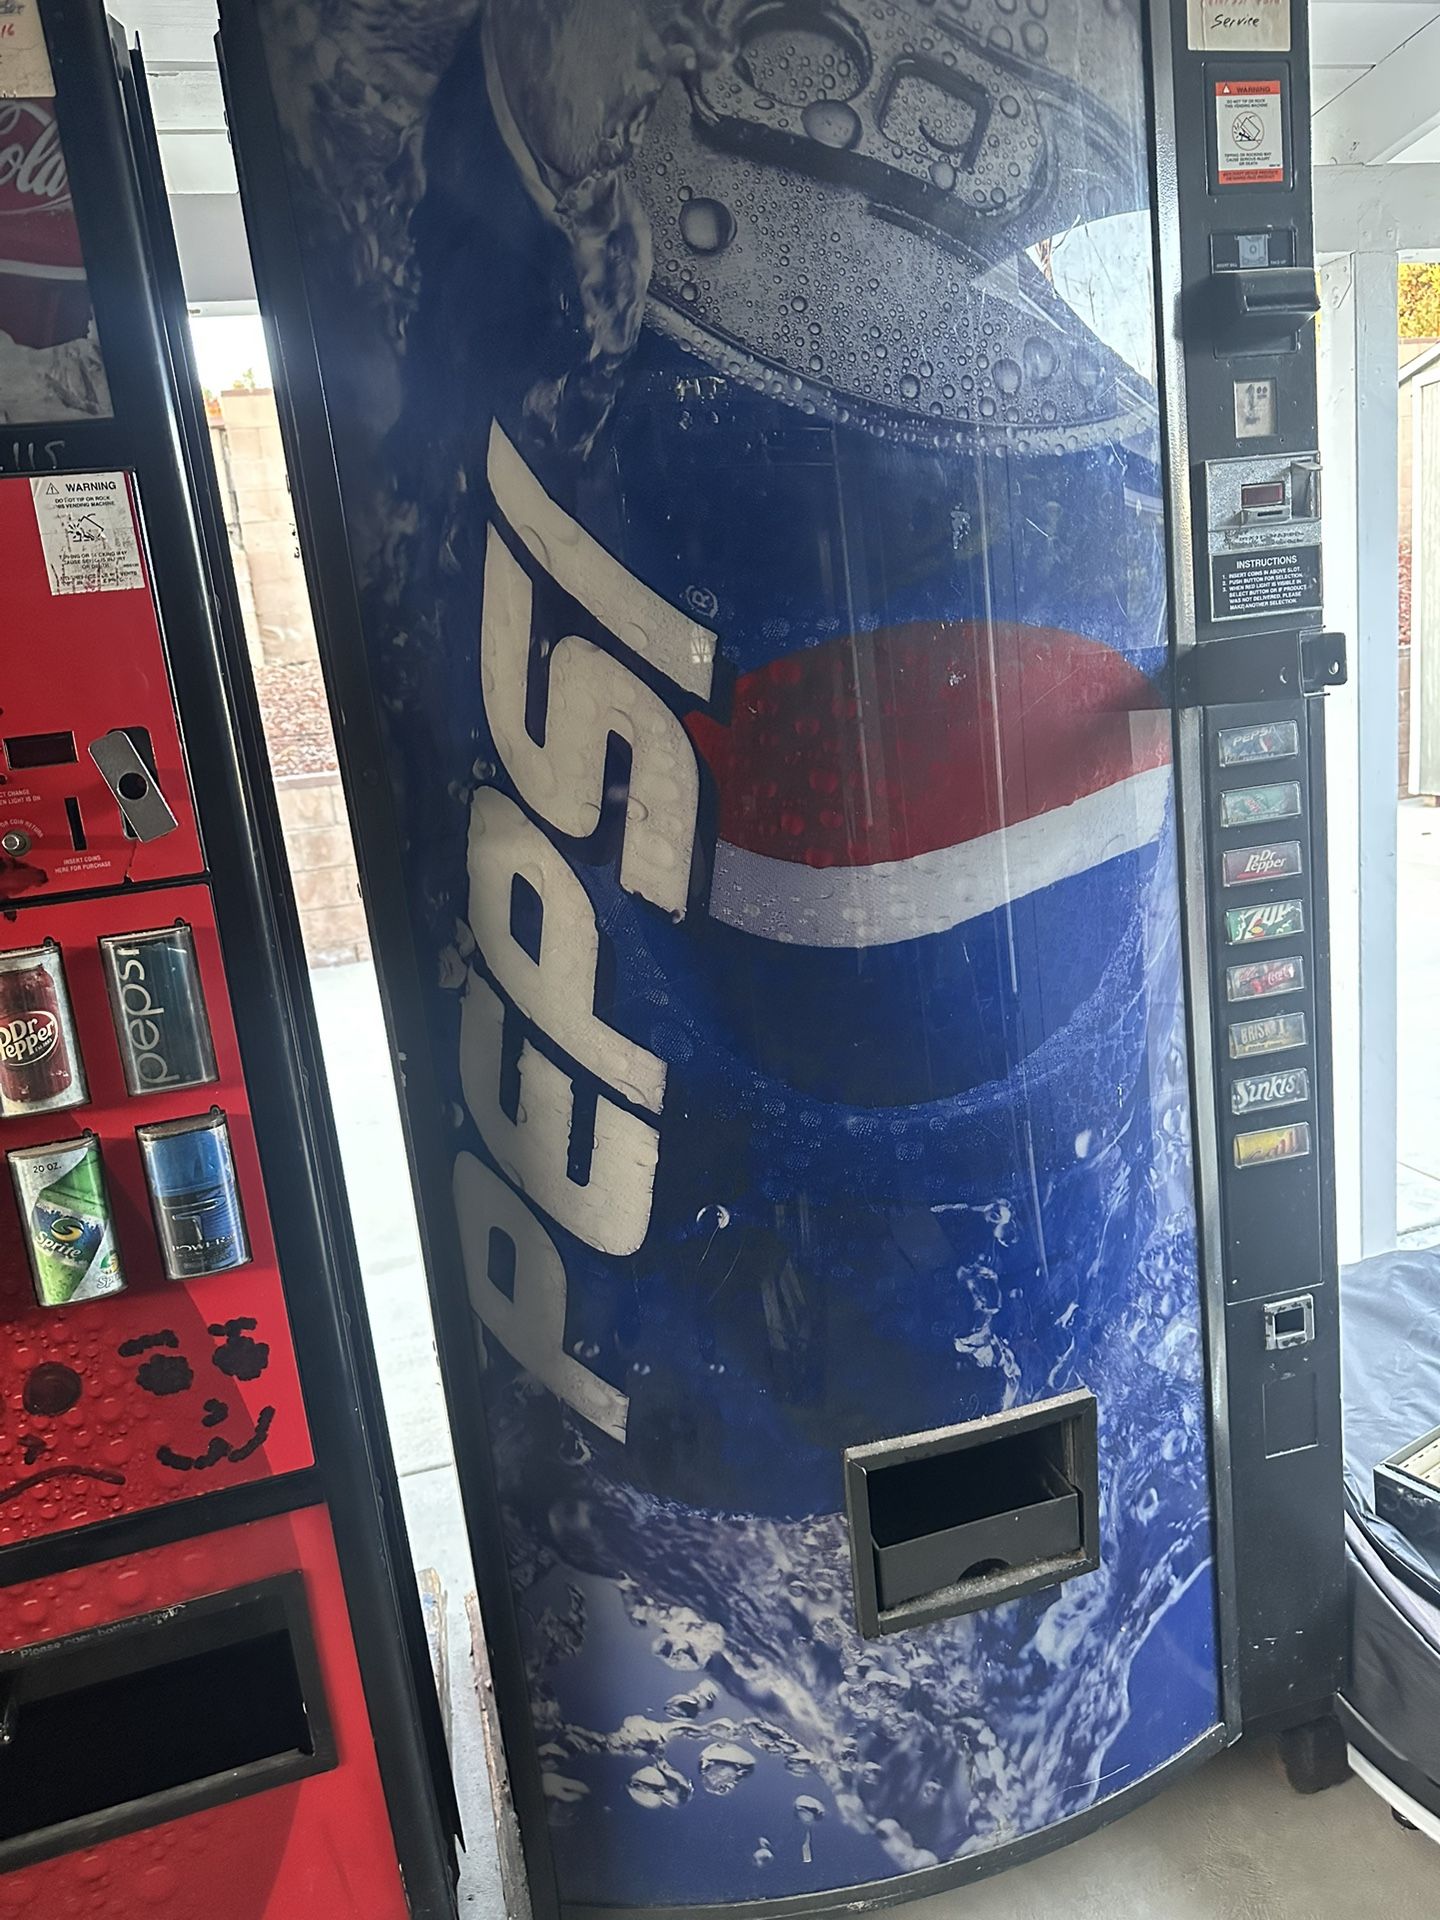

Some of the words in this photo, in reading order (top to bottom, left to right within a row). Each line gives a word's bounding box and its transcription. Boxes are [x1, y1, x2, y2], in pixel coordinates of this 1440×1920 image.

[1210, 14, 1260, 29] Service
[0, 101, 69, 197] ola
[65, 481, 117, 492] WARNING
[1236, 555, 1298, 569] INSTRUCTIONS
[1249, 588, 1269, 596] BUTTON
[1283, 584, 1307, 592] PRODUCT
[1282, 591, 1302, 599] PLEASE
[7, 789, 30, 797] CHANGE
[8, 796, 25, 804] LIGHT
[63, 857, 83, 865] INSERT
[84, 854, 101, 863] COINS
[1260, 849, 1276, 861] Dr
[82, 860, 111, 870] PURCHASE
[1244, 853, 1287, 874] Pepper
[452, 421, 718, 1446] PEPSI
[8, 1018, 38, 1043] Dr
[0, 1020, 54, 1061] Pepper
[1232, 1073, 1302, 1109] Sunkis
[33, 1165, 45, 1173] 20
[46, 1162, 62, 1171] OZ.
[35, 1231, 82, 1260] Sprite
